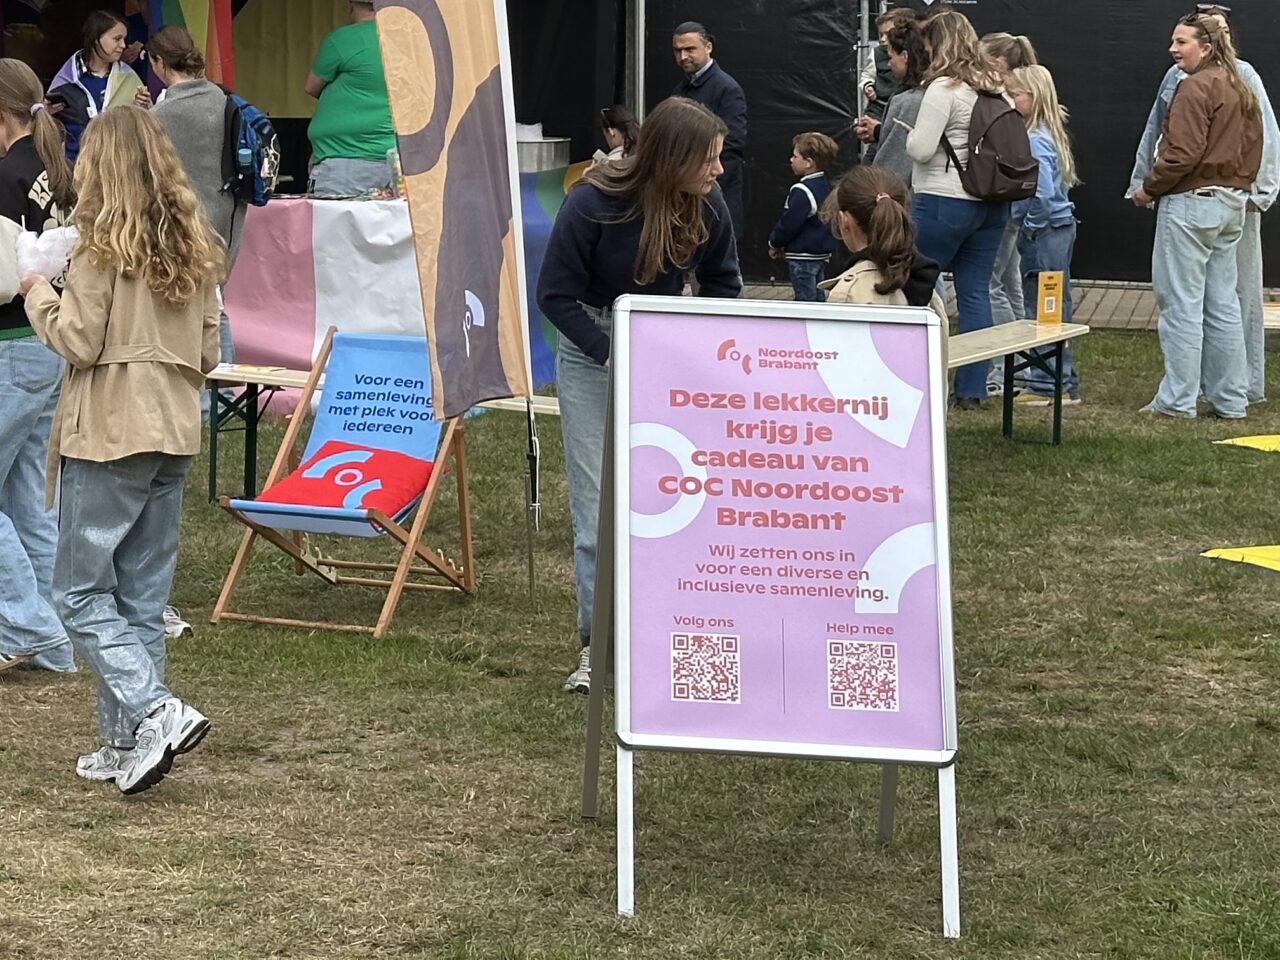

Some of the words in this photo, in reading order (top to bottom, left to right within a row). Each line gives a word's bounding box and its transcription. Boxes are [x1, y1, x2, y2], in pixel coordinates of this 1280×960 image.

[758, 347, 839, 360] Noordoost
[758, 359, 819, 370] Brabant
[354, 373, 391, 387] Voor
[393, 377, 424, 390] een
[328, 404, 360, 417] met
[361, 405, 397, 419] plek
[670, 388, 746, 410] Deze
[753, 392, 889, 421] lekkernij
[342, 419, 414, 436] iedereen
[726, 420, 798, 445] krijg
[803, 421, 833, 446] je
[691, 449, 805, 470] cadeau
[812, 454, 869, 472] van
[658, 476, 724, 496] COC
[731, 479, 904, 503] Noordoost
[716, 507, 846, 531] Brabant
[708, 544, 736, 560] Wij
[739, 547, 798, 561] zetten
[802, 549, 835, 562] ons
[839, 549, 856, 562] in
[695, 562, 736, 575] voor
[739, 564, 772, 577] een
[777, 565, 843, 580] diverse
[847, 569, 870, 581] en
[677, 578, 766, 595] inclusieve
[770, 584, 889, 602] samenleving.
[673, 615, 705, 629] Volg
[707, 617, 734, 628] ons
[826, 622, 859, 636] Help
[862, 624, 894, 635] mee
